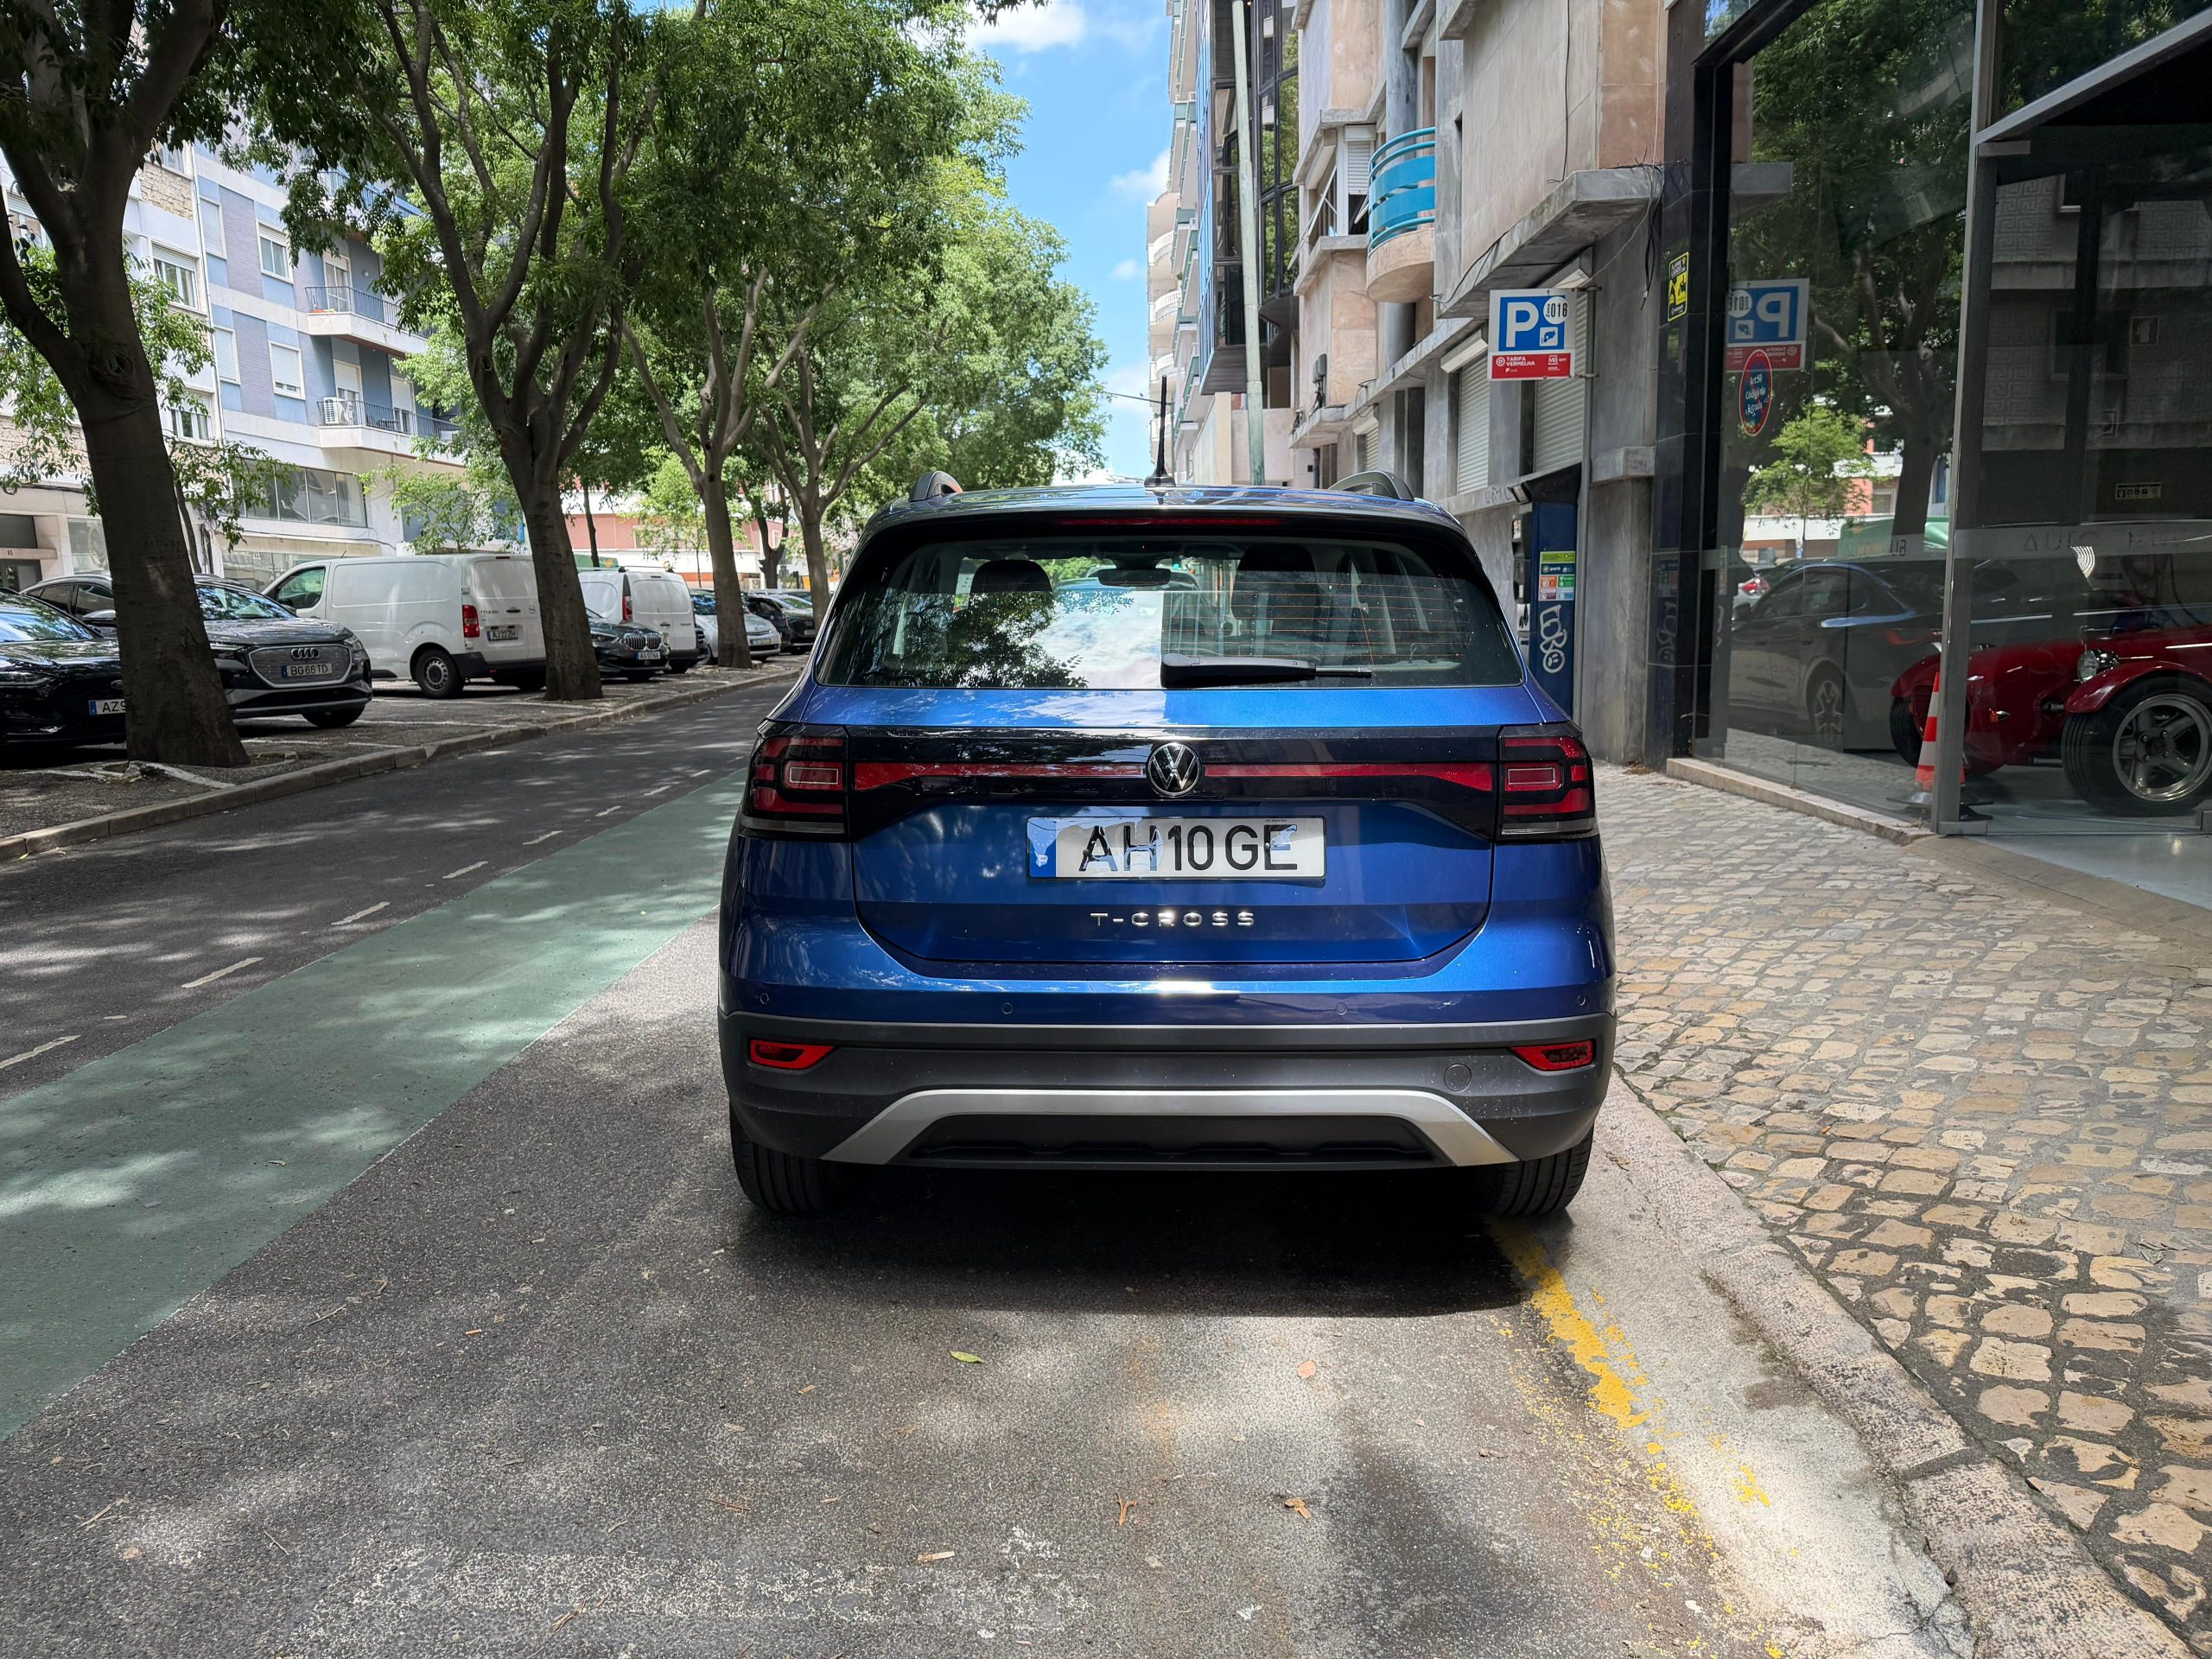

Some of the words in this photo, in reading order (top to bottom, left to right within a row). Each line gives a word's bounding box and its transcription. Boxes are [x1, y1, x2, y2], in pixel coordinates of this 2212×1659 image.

[1551, 302, 1567, 317] 016
[1506, 302, 1539, 347] P
[1090, 912, 1255, 927] T-CROSS
